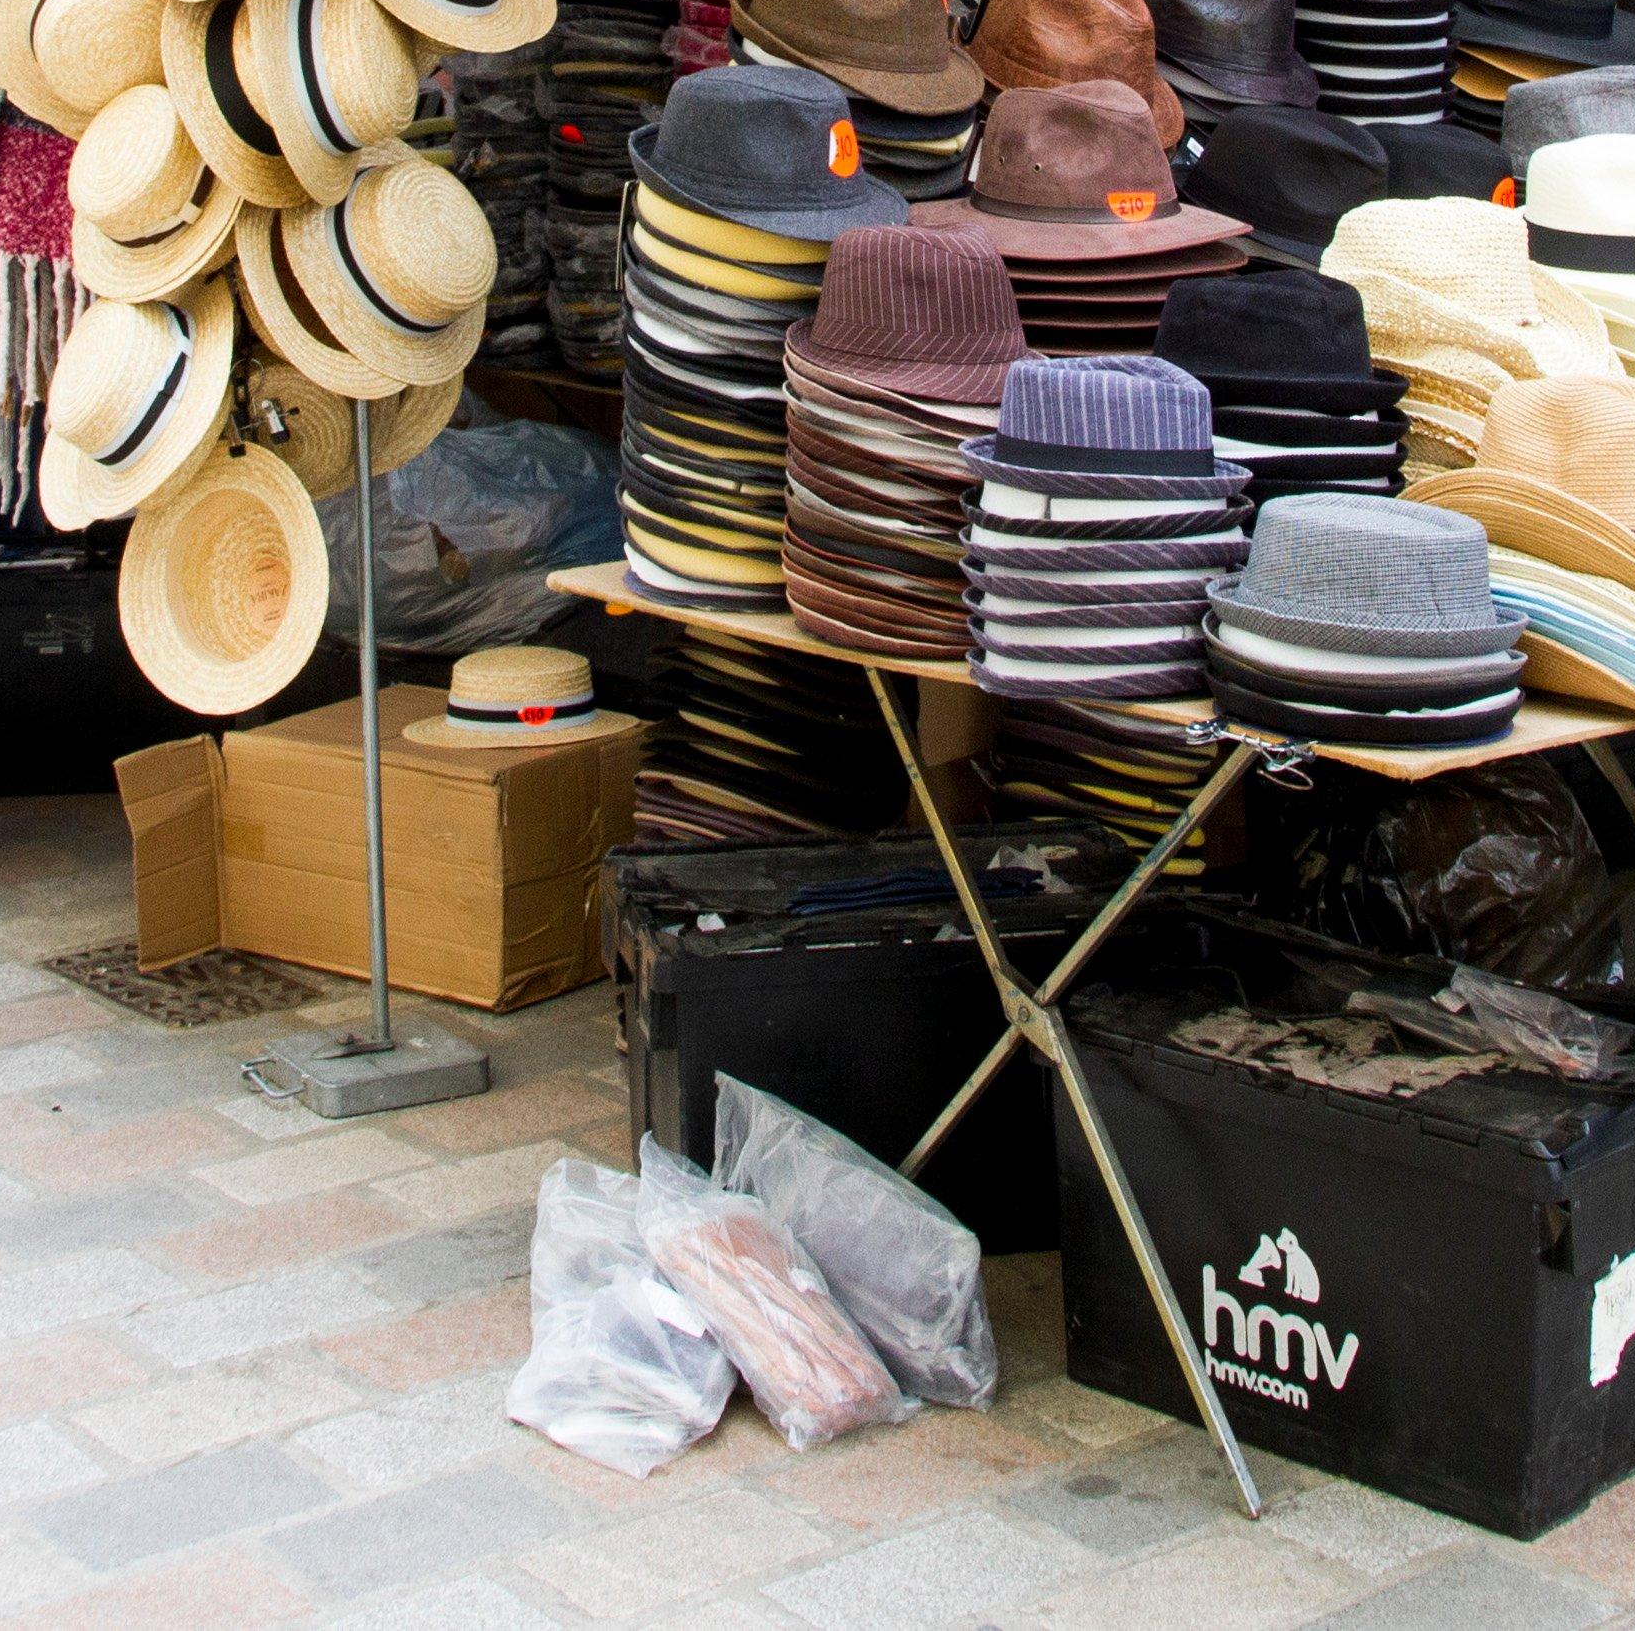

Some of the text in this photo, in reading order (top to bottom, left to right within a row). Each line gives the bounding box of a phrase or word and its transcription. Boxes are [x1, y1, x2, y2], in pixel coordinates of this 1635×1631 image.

[1118, 197, 1144, 216] £10
[1203, 1264, 1359, 1390] hmv
[1204, 1347, 1309, 1411] hmv.com
